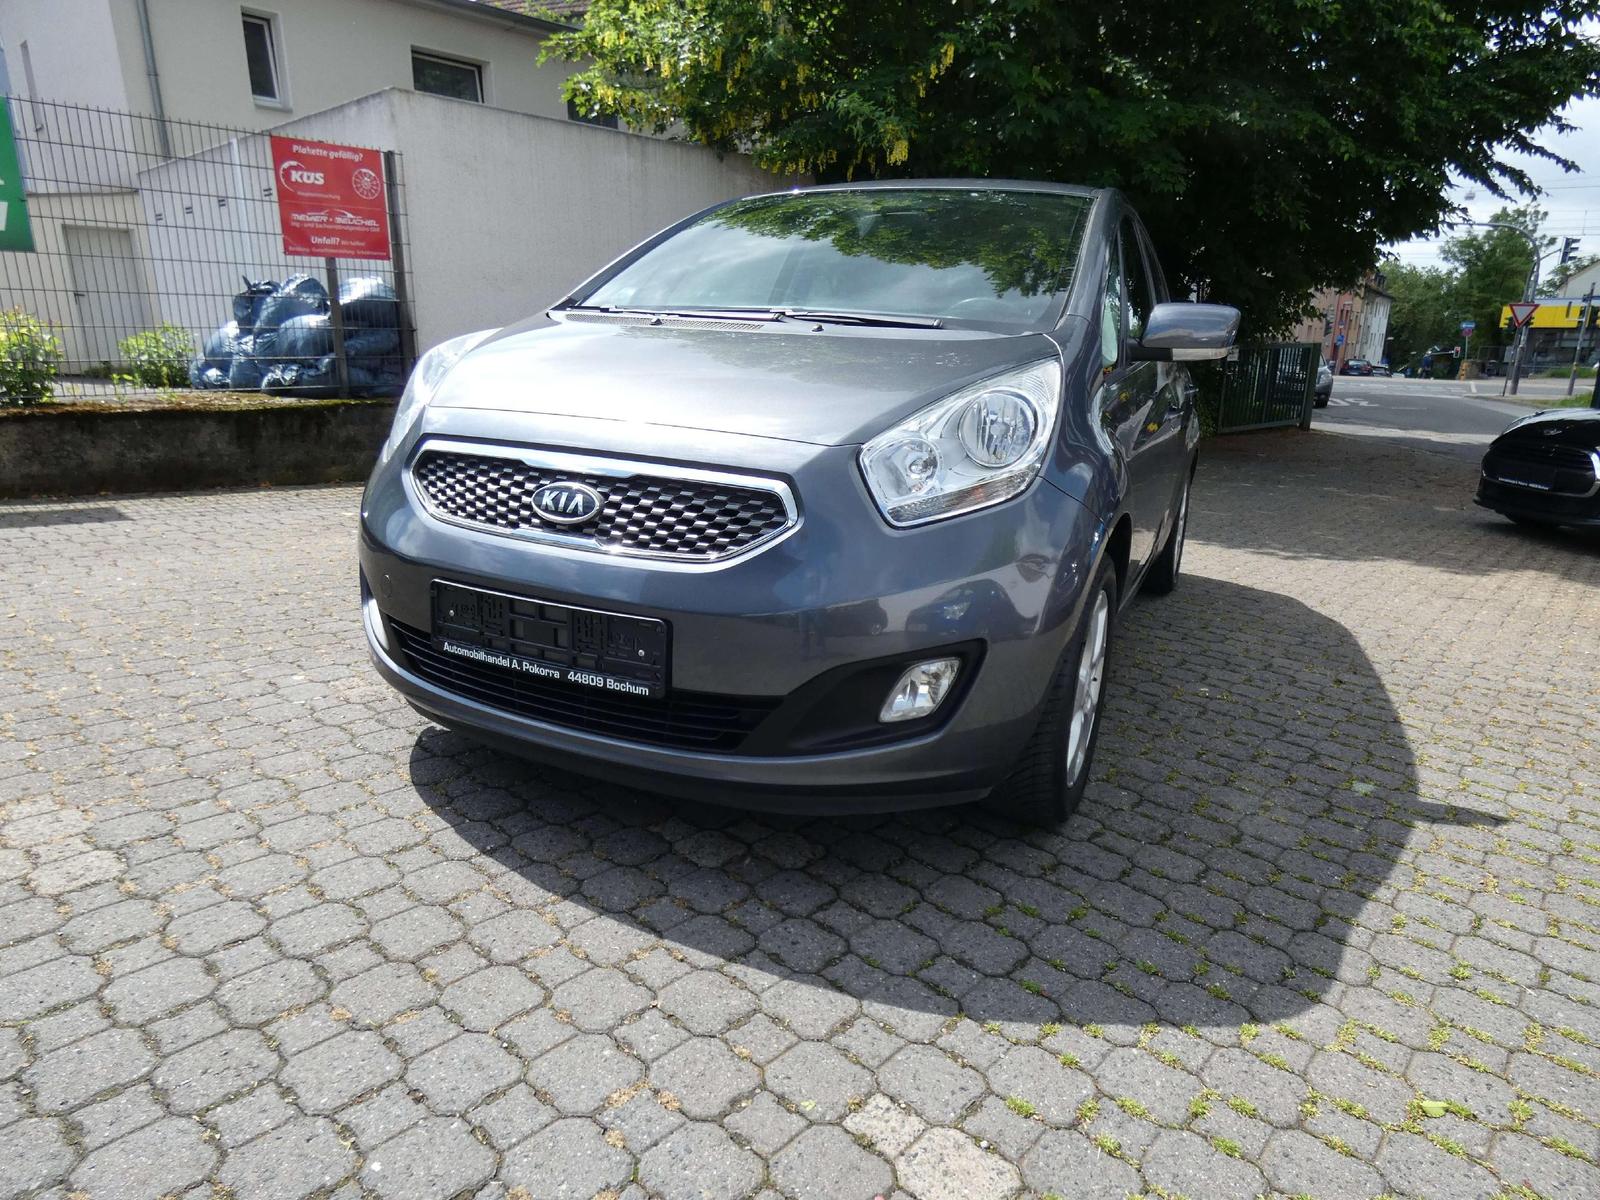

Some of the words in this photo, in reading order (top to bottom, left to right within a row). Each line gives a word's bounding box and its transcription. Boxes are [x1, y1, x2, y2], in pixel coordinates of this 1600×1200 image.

[292, 144, 327, 156] Plakette
[329, 150, 364, 162] gefällig?
[311, 235, 340, 245] Unfall?
[540, 490, 584, 516] KIA
[443, 642, 510, 667] Automobilhandel
[511, 659, 521, 670] A.
[522, 661, 560, 679] Pokorra
[567, 671, 604, 687] 44809
[606, 678, 649, 696] Bochum
